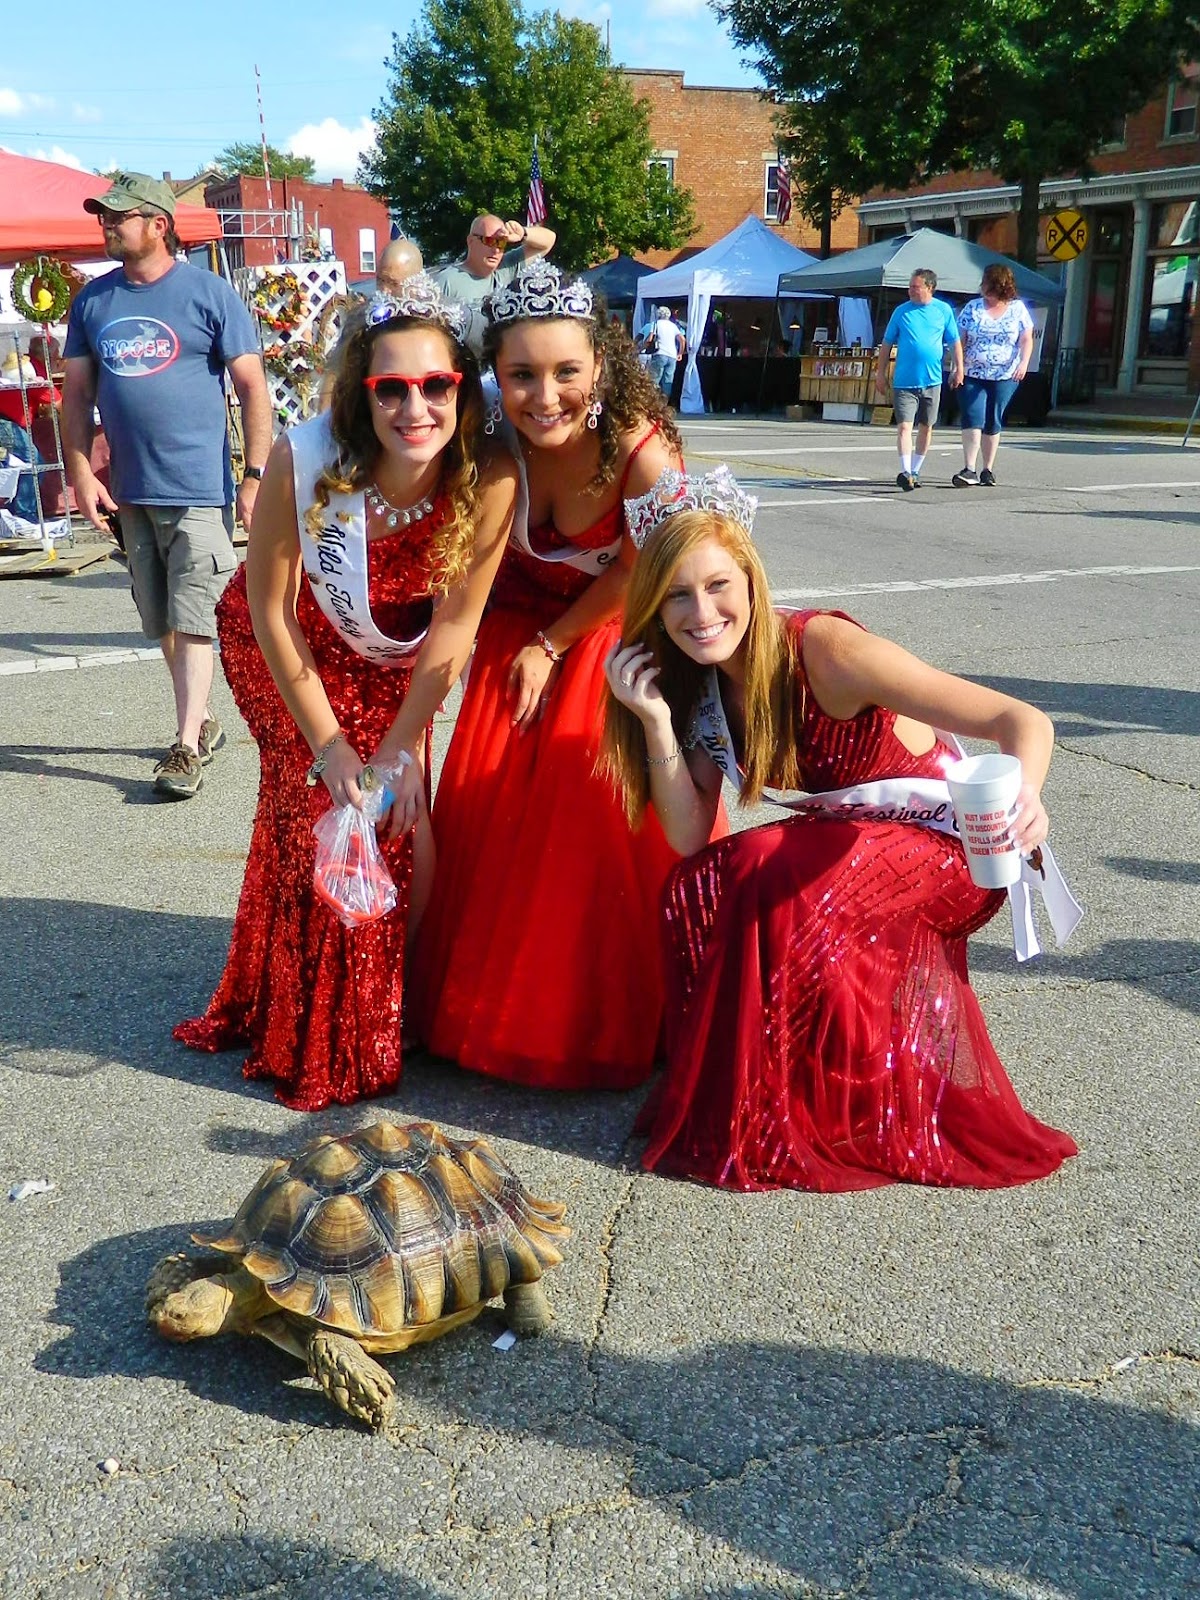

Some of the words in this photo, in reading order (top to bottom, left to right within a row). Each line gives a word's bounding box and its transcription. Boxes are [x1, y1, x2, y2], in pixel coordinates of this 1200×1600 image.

[1048, 229, 1058, 242] R
[1076, 229, 1085, 242] R
[101, 339, 171, 358] MOOSE
[833, 802, 947, 823] Festival
[964, 813, 978, 822] MUST
[979, 812, 993, 821] HAVE
[994, 809, 1005, 820] CUP
[975, 820, 1008, 832] DISCOUNTED
[968, 835, 990, 845] REFILLS
